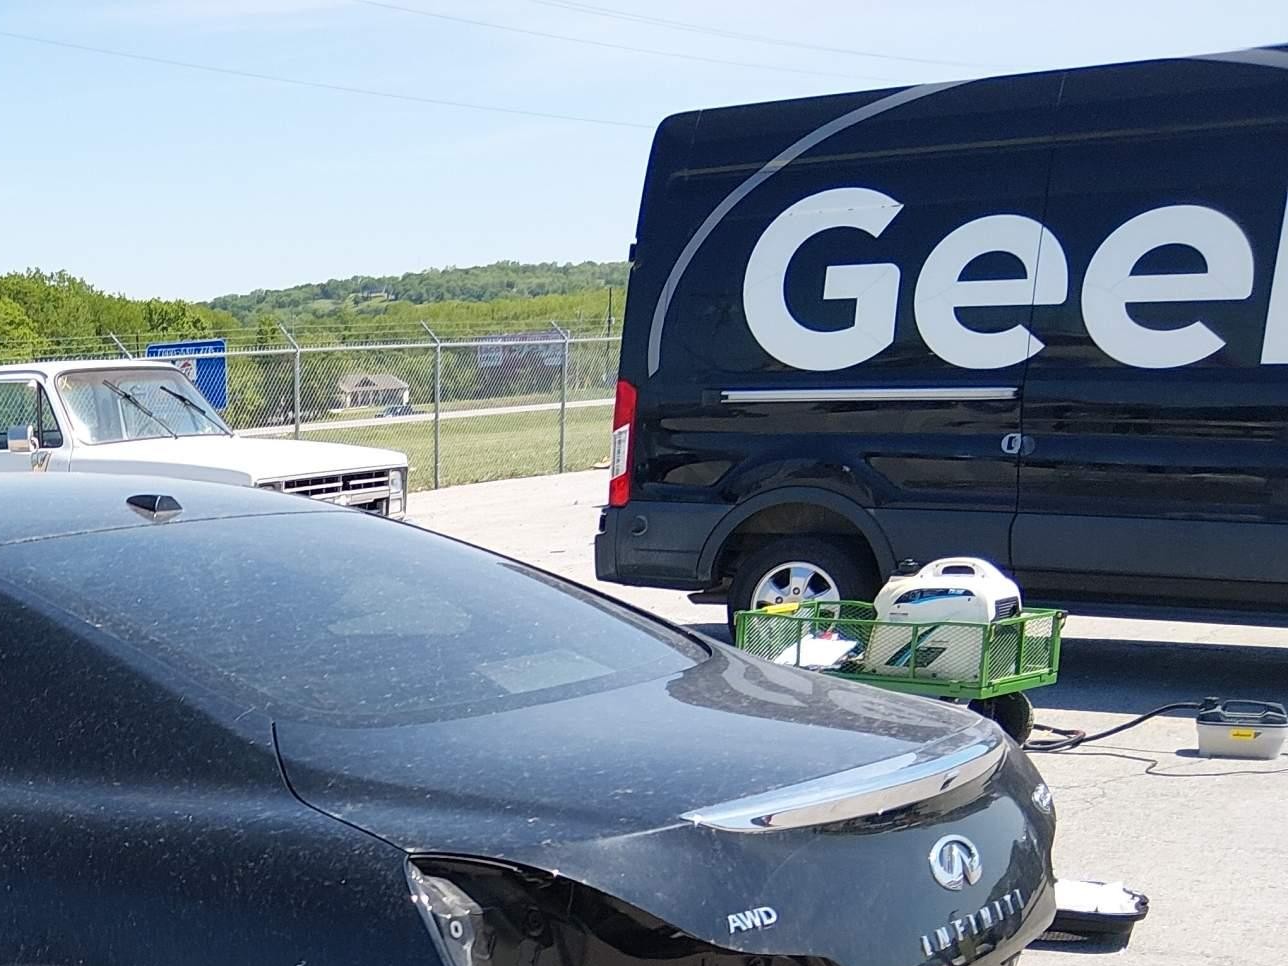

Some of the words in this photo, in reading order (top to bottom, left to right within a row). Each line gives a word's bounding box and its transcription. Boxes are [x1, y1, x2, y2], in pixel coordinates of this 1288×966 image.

[743, 186, 1288, 371] Gee
[727, 906, 778, 934] AWD
[920, 888, 1024, 956] INFINITI
